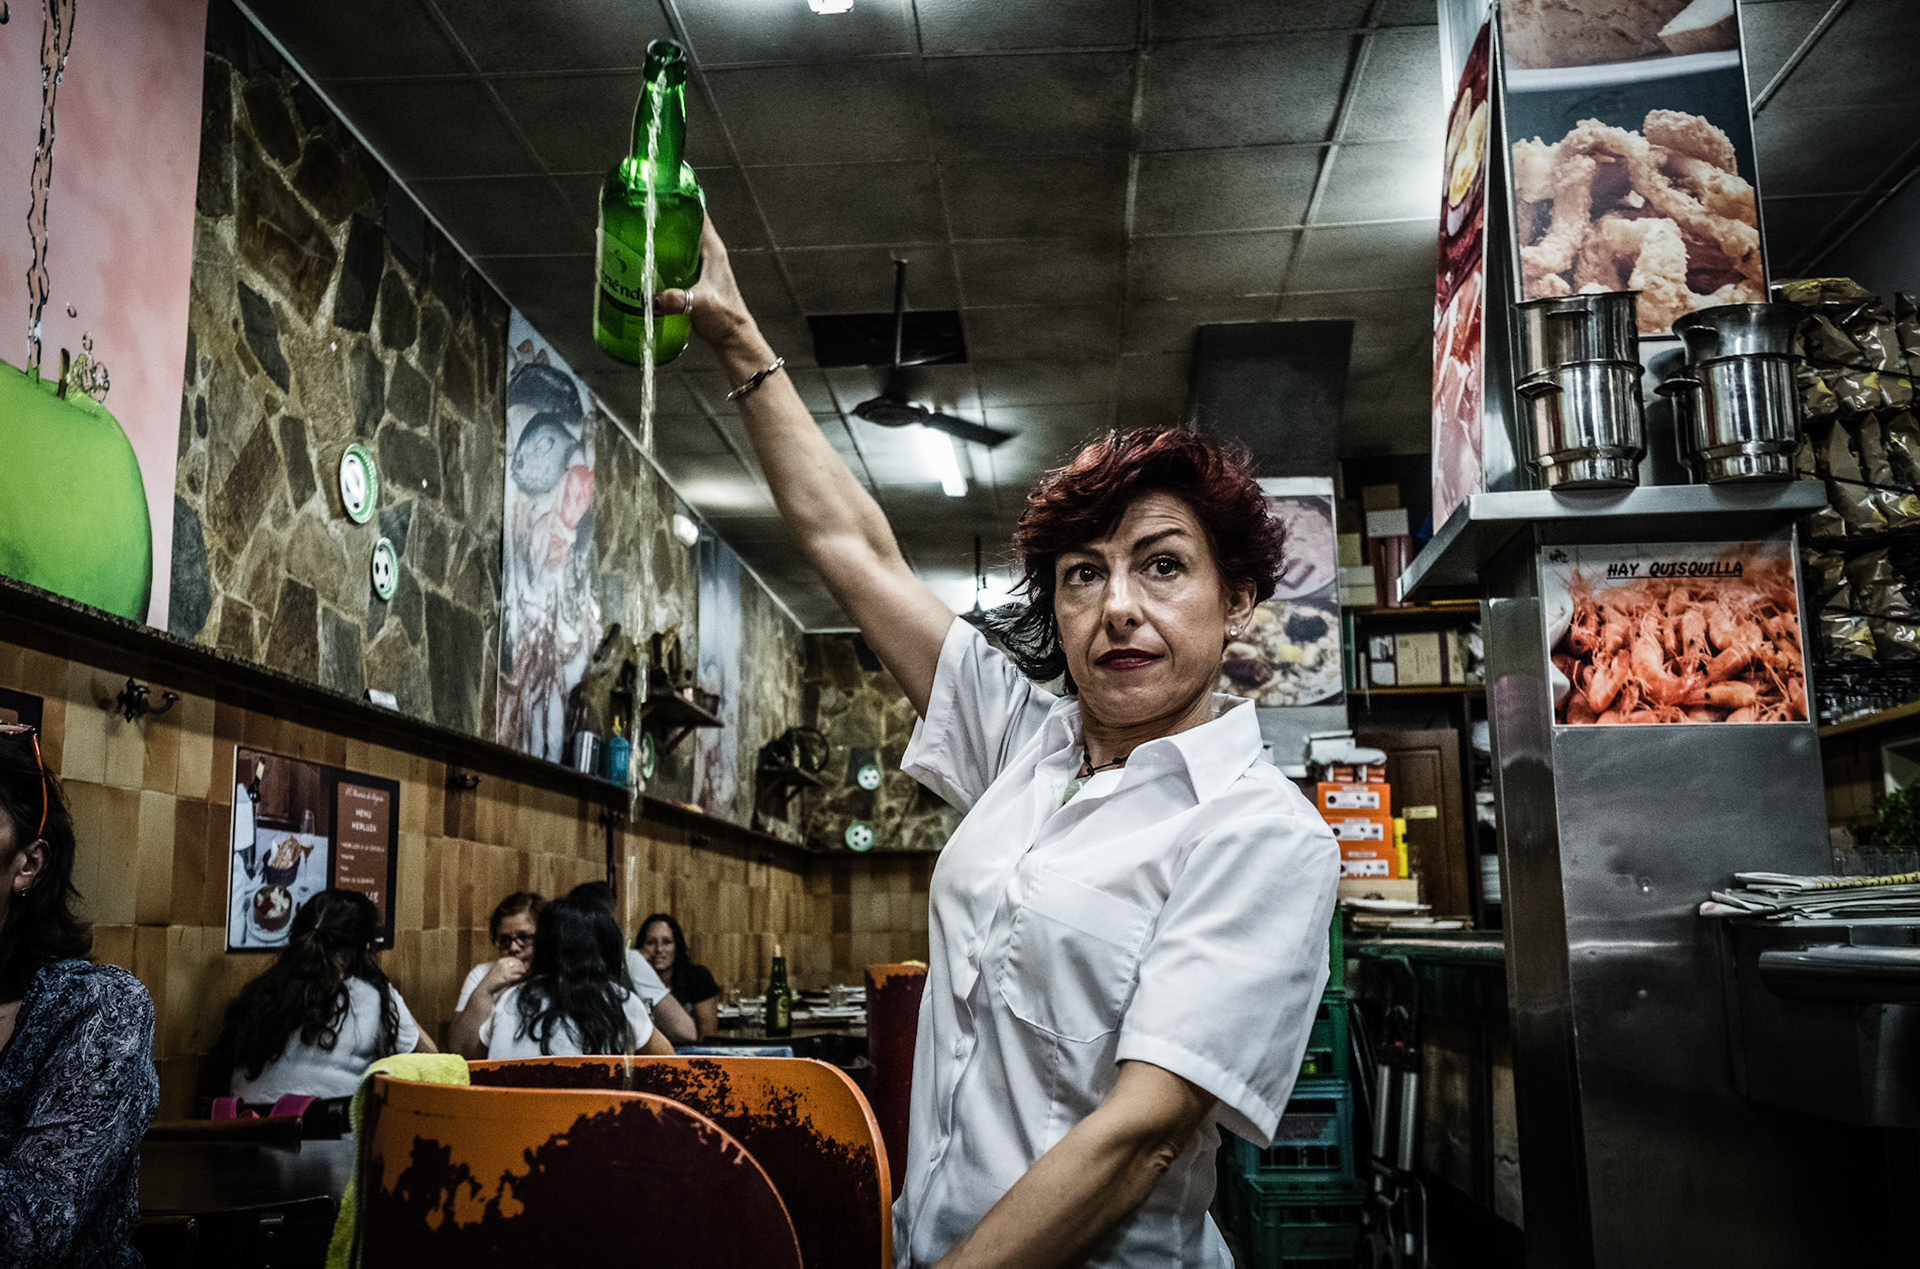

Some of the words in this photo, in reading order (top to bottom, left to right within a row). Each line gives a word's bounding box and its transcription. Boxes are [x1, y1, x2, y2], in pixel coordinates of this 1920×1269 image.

[1607, 563, 1639, 577] HAY
[1649, 562, 1743, 577] QUISQUILLA
[351, 821, 377, 833] MERLUZA
